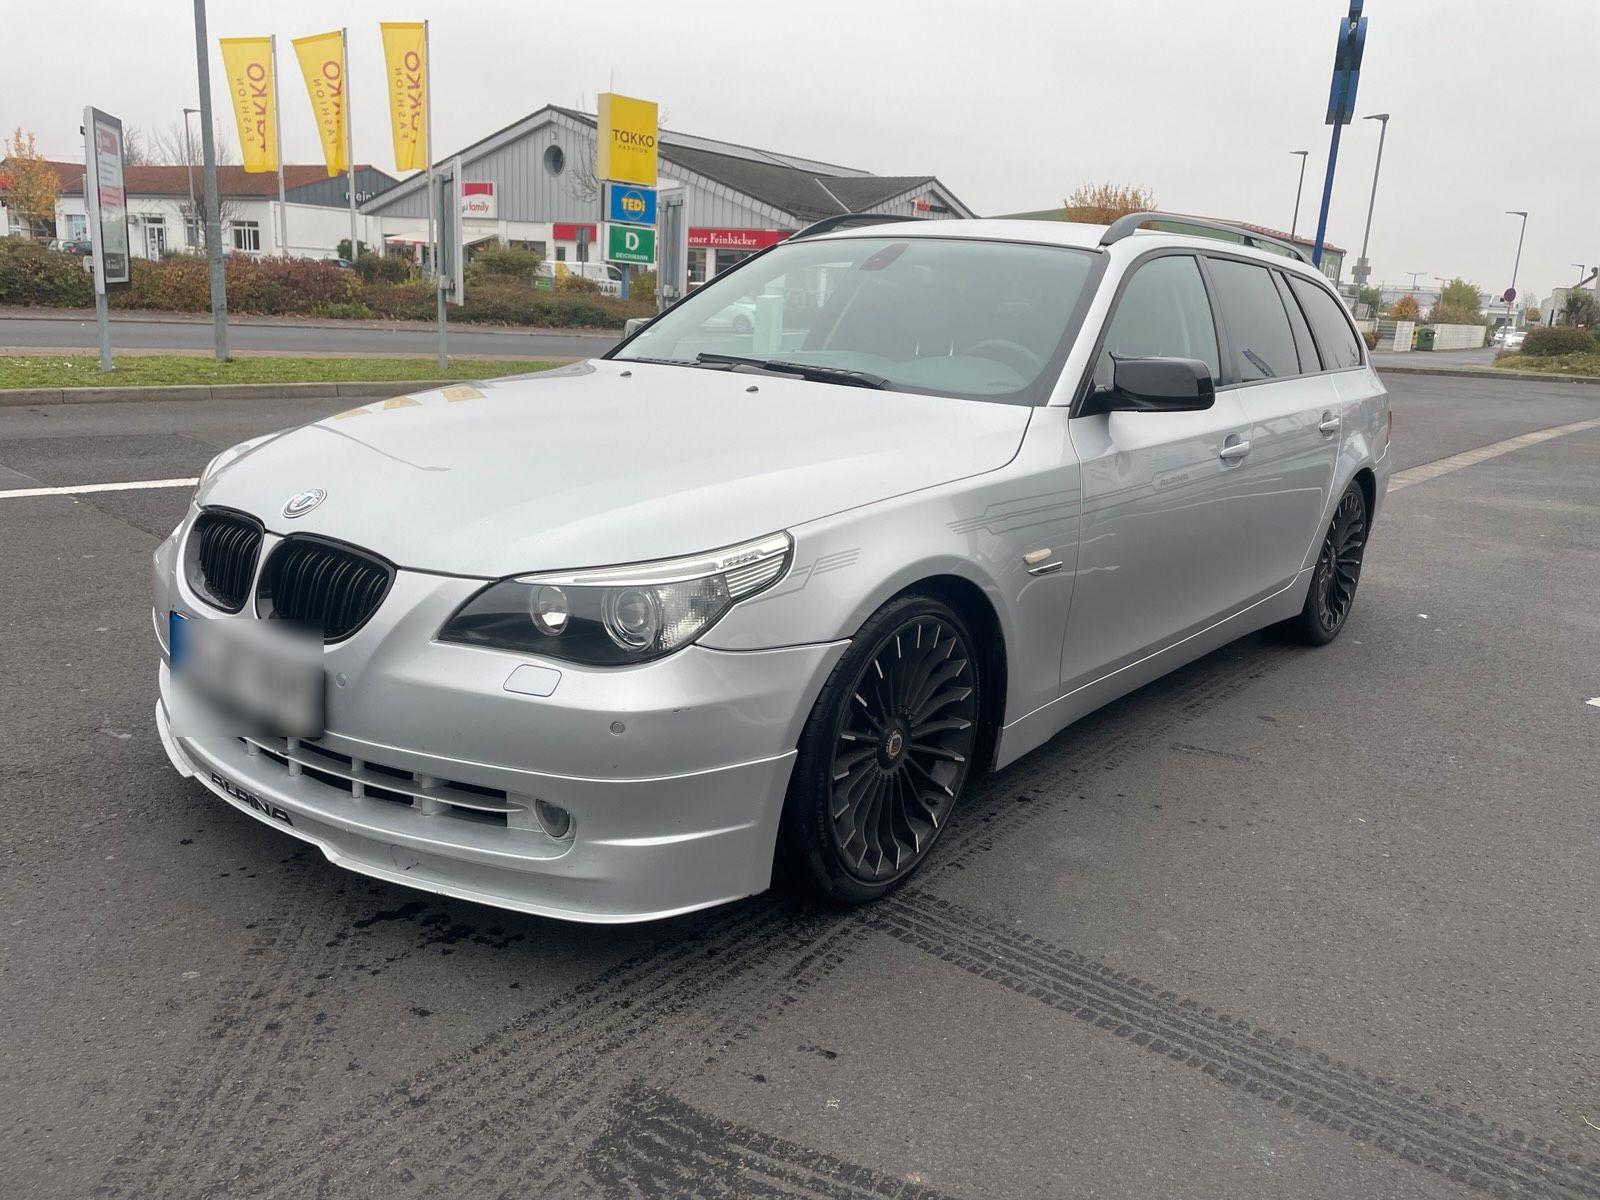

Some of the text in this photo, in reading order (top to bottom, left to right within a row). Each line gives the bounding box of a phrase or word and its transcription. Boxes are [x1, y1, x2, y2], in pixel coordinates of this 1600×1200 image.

[617, 144, 649, 154] FASHION
[469, 201, 489, 213] family
[625, 231, 640, 251] D
[709, 232, 757, 245] Feinbäcker
[615, 252, 648, 261] DEICHMANN
[211, 771, 294, 827] ALPINA
